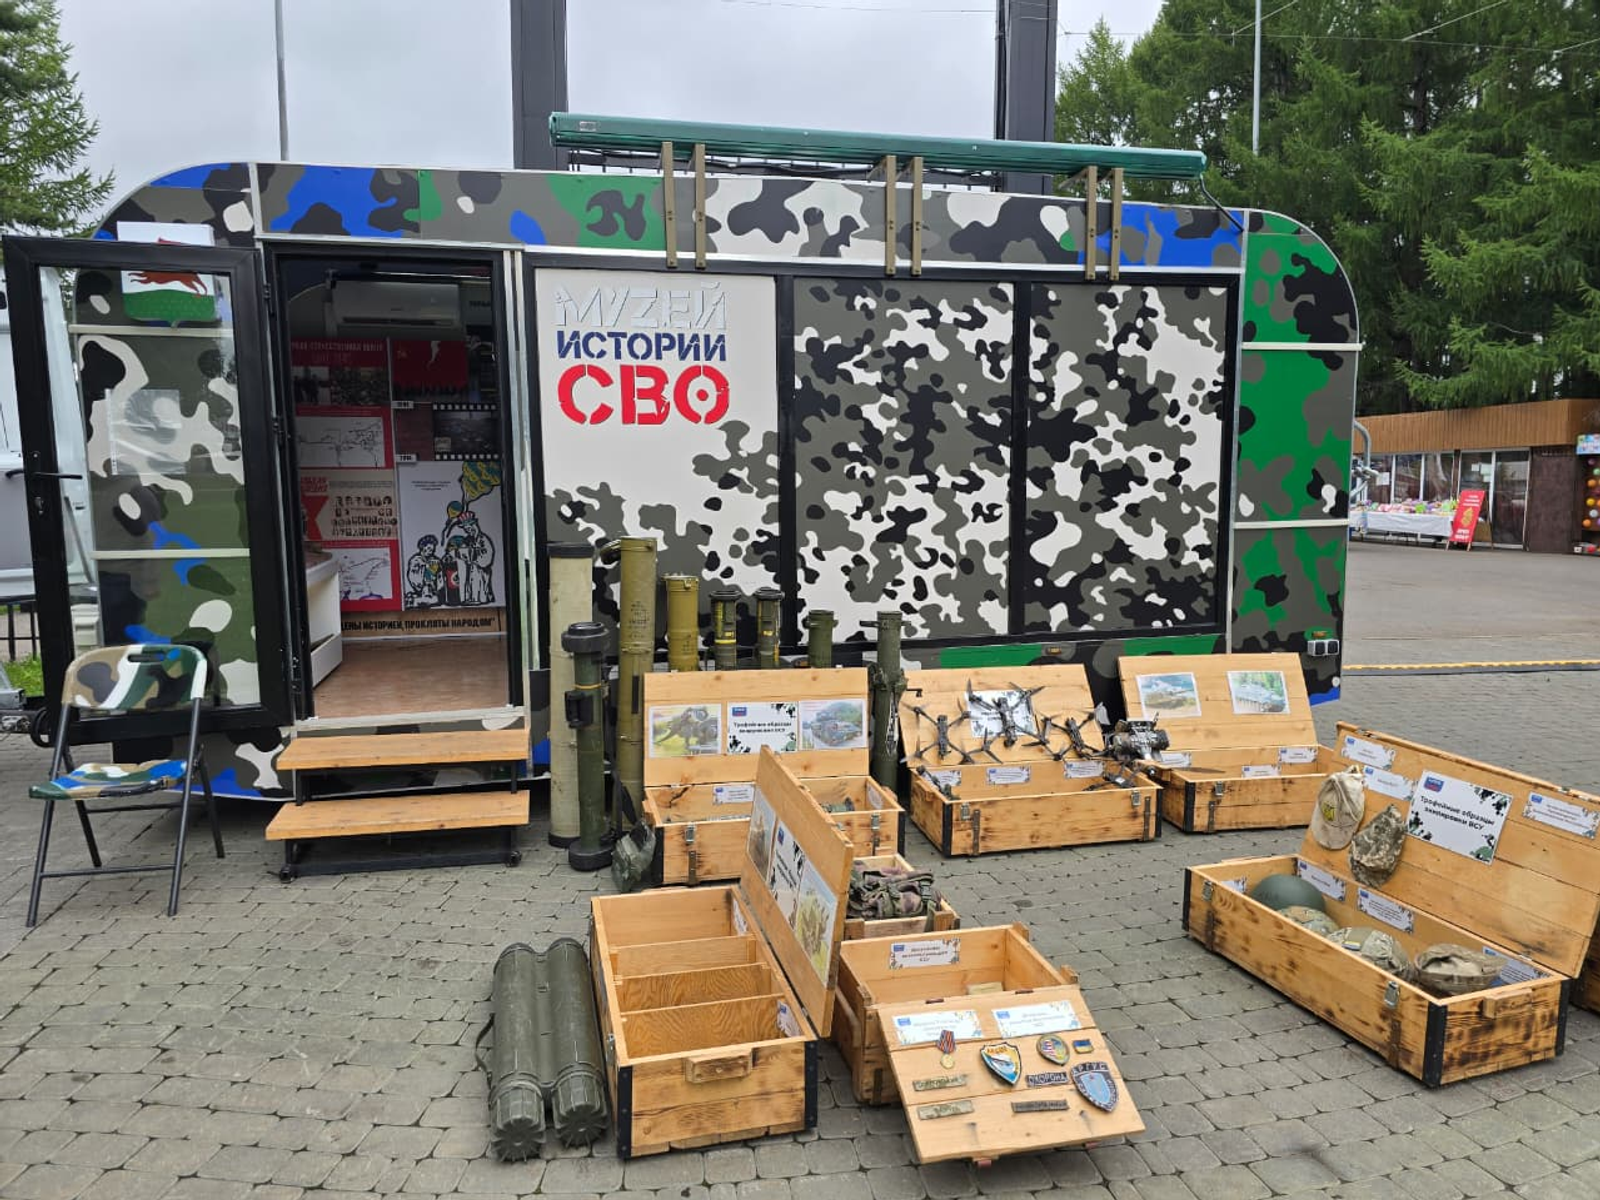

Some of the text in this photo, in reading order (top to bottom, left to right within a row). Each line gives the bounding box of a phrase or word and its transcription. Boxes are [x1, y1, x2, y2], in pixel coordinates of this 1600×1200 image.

[557, 331, 727, 362] ИСТОРИИ
[557, 364, 730, 425] СВО
[1469, 820, 1485, 831] ВСУ
